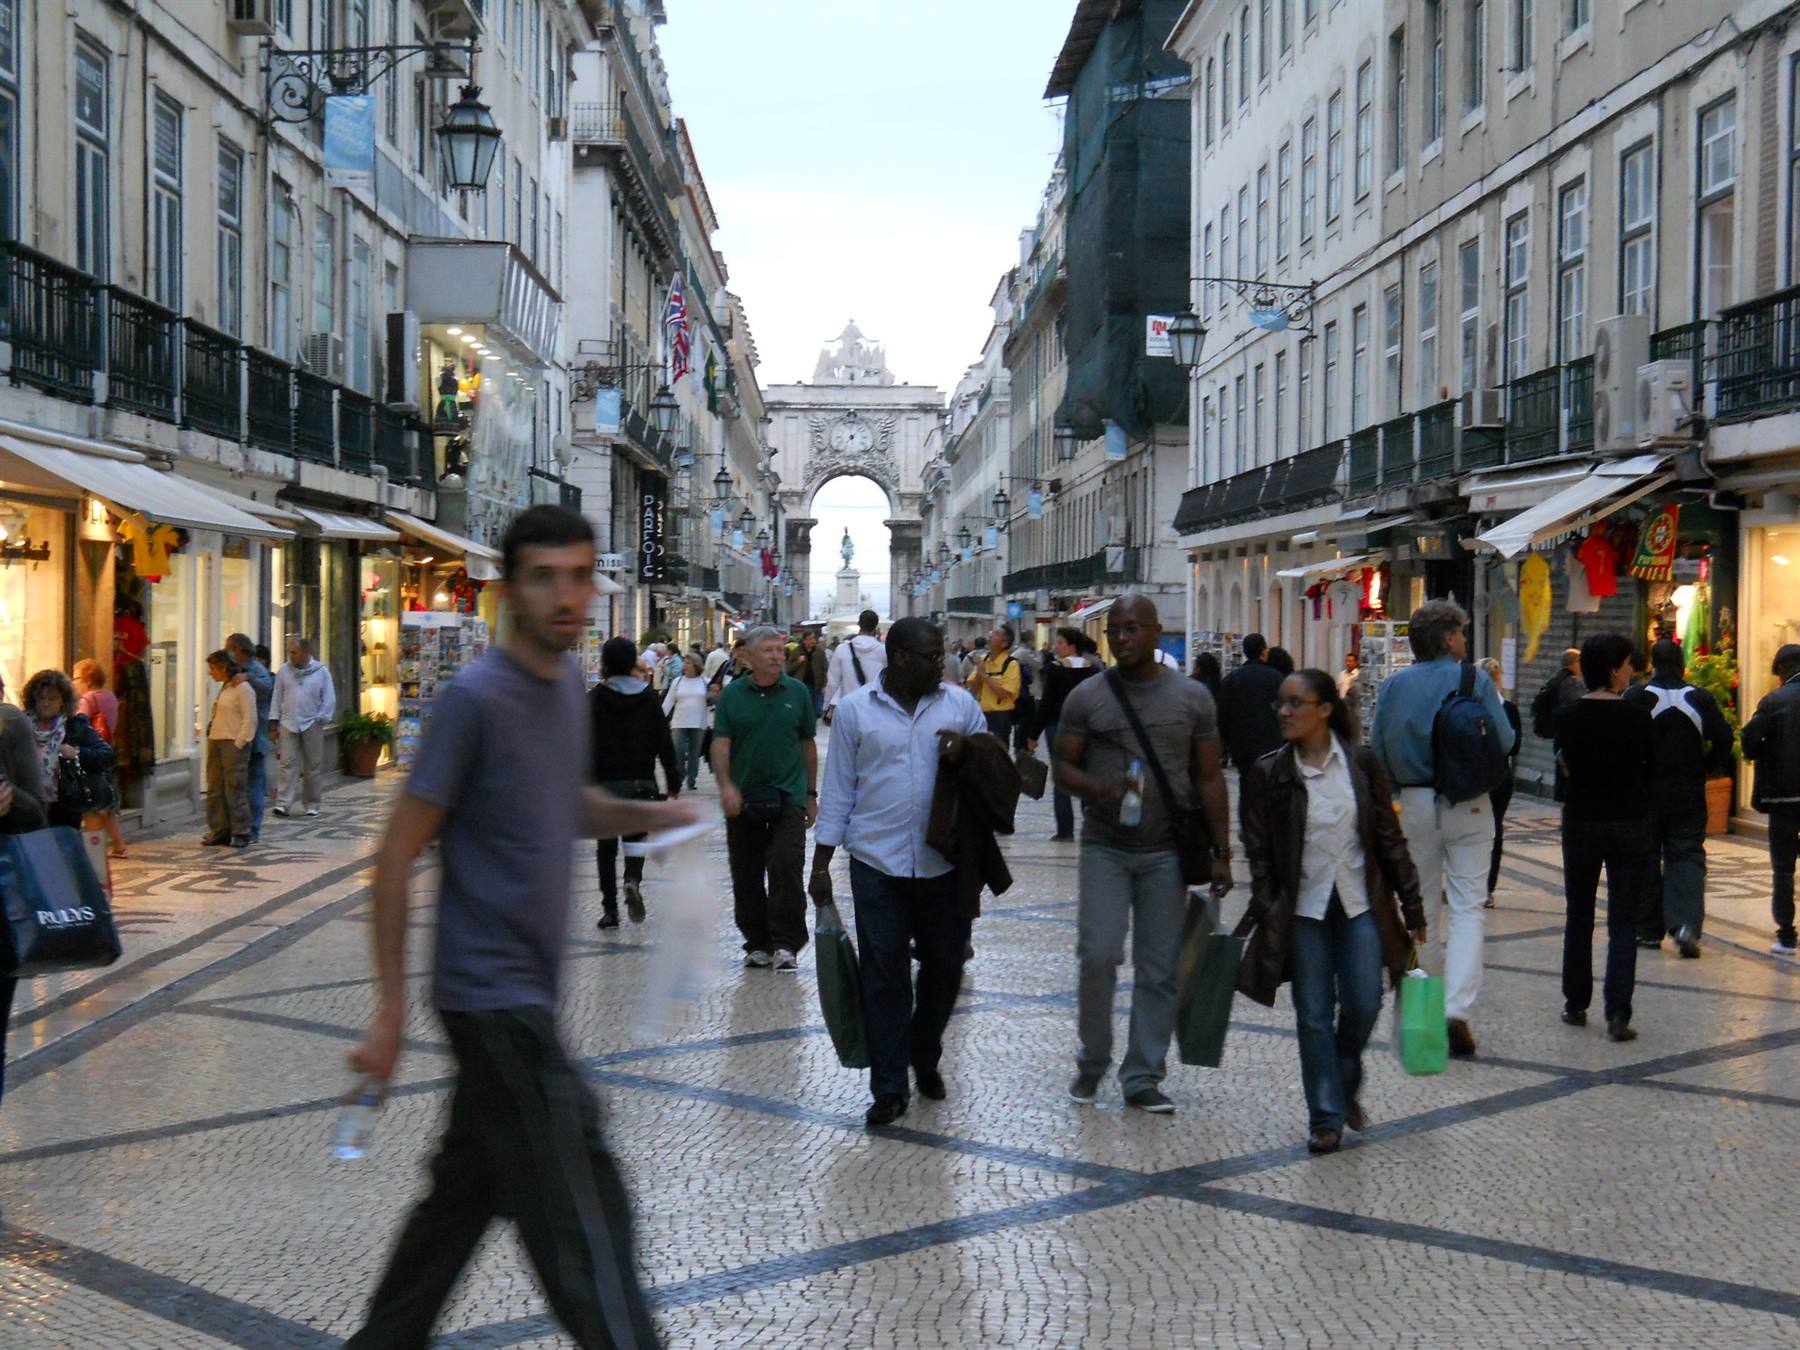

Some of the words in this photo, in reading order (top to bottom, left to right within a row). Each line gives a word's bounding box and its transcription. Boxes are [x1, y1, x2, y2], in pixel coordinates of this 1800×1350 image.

[643, 494, 655, 577] PARFOIS
[1340, 591, 1348, 605] 7
[36, 906, 96, 925] RULYS
